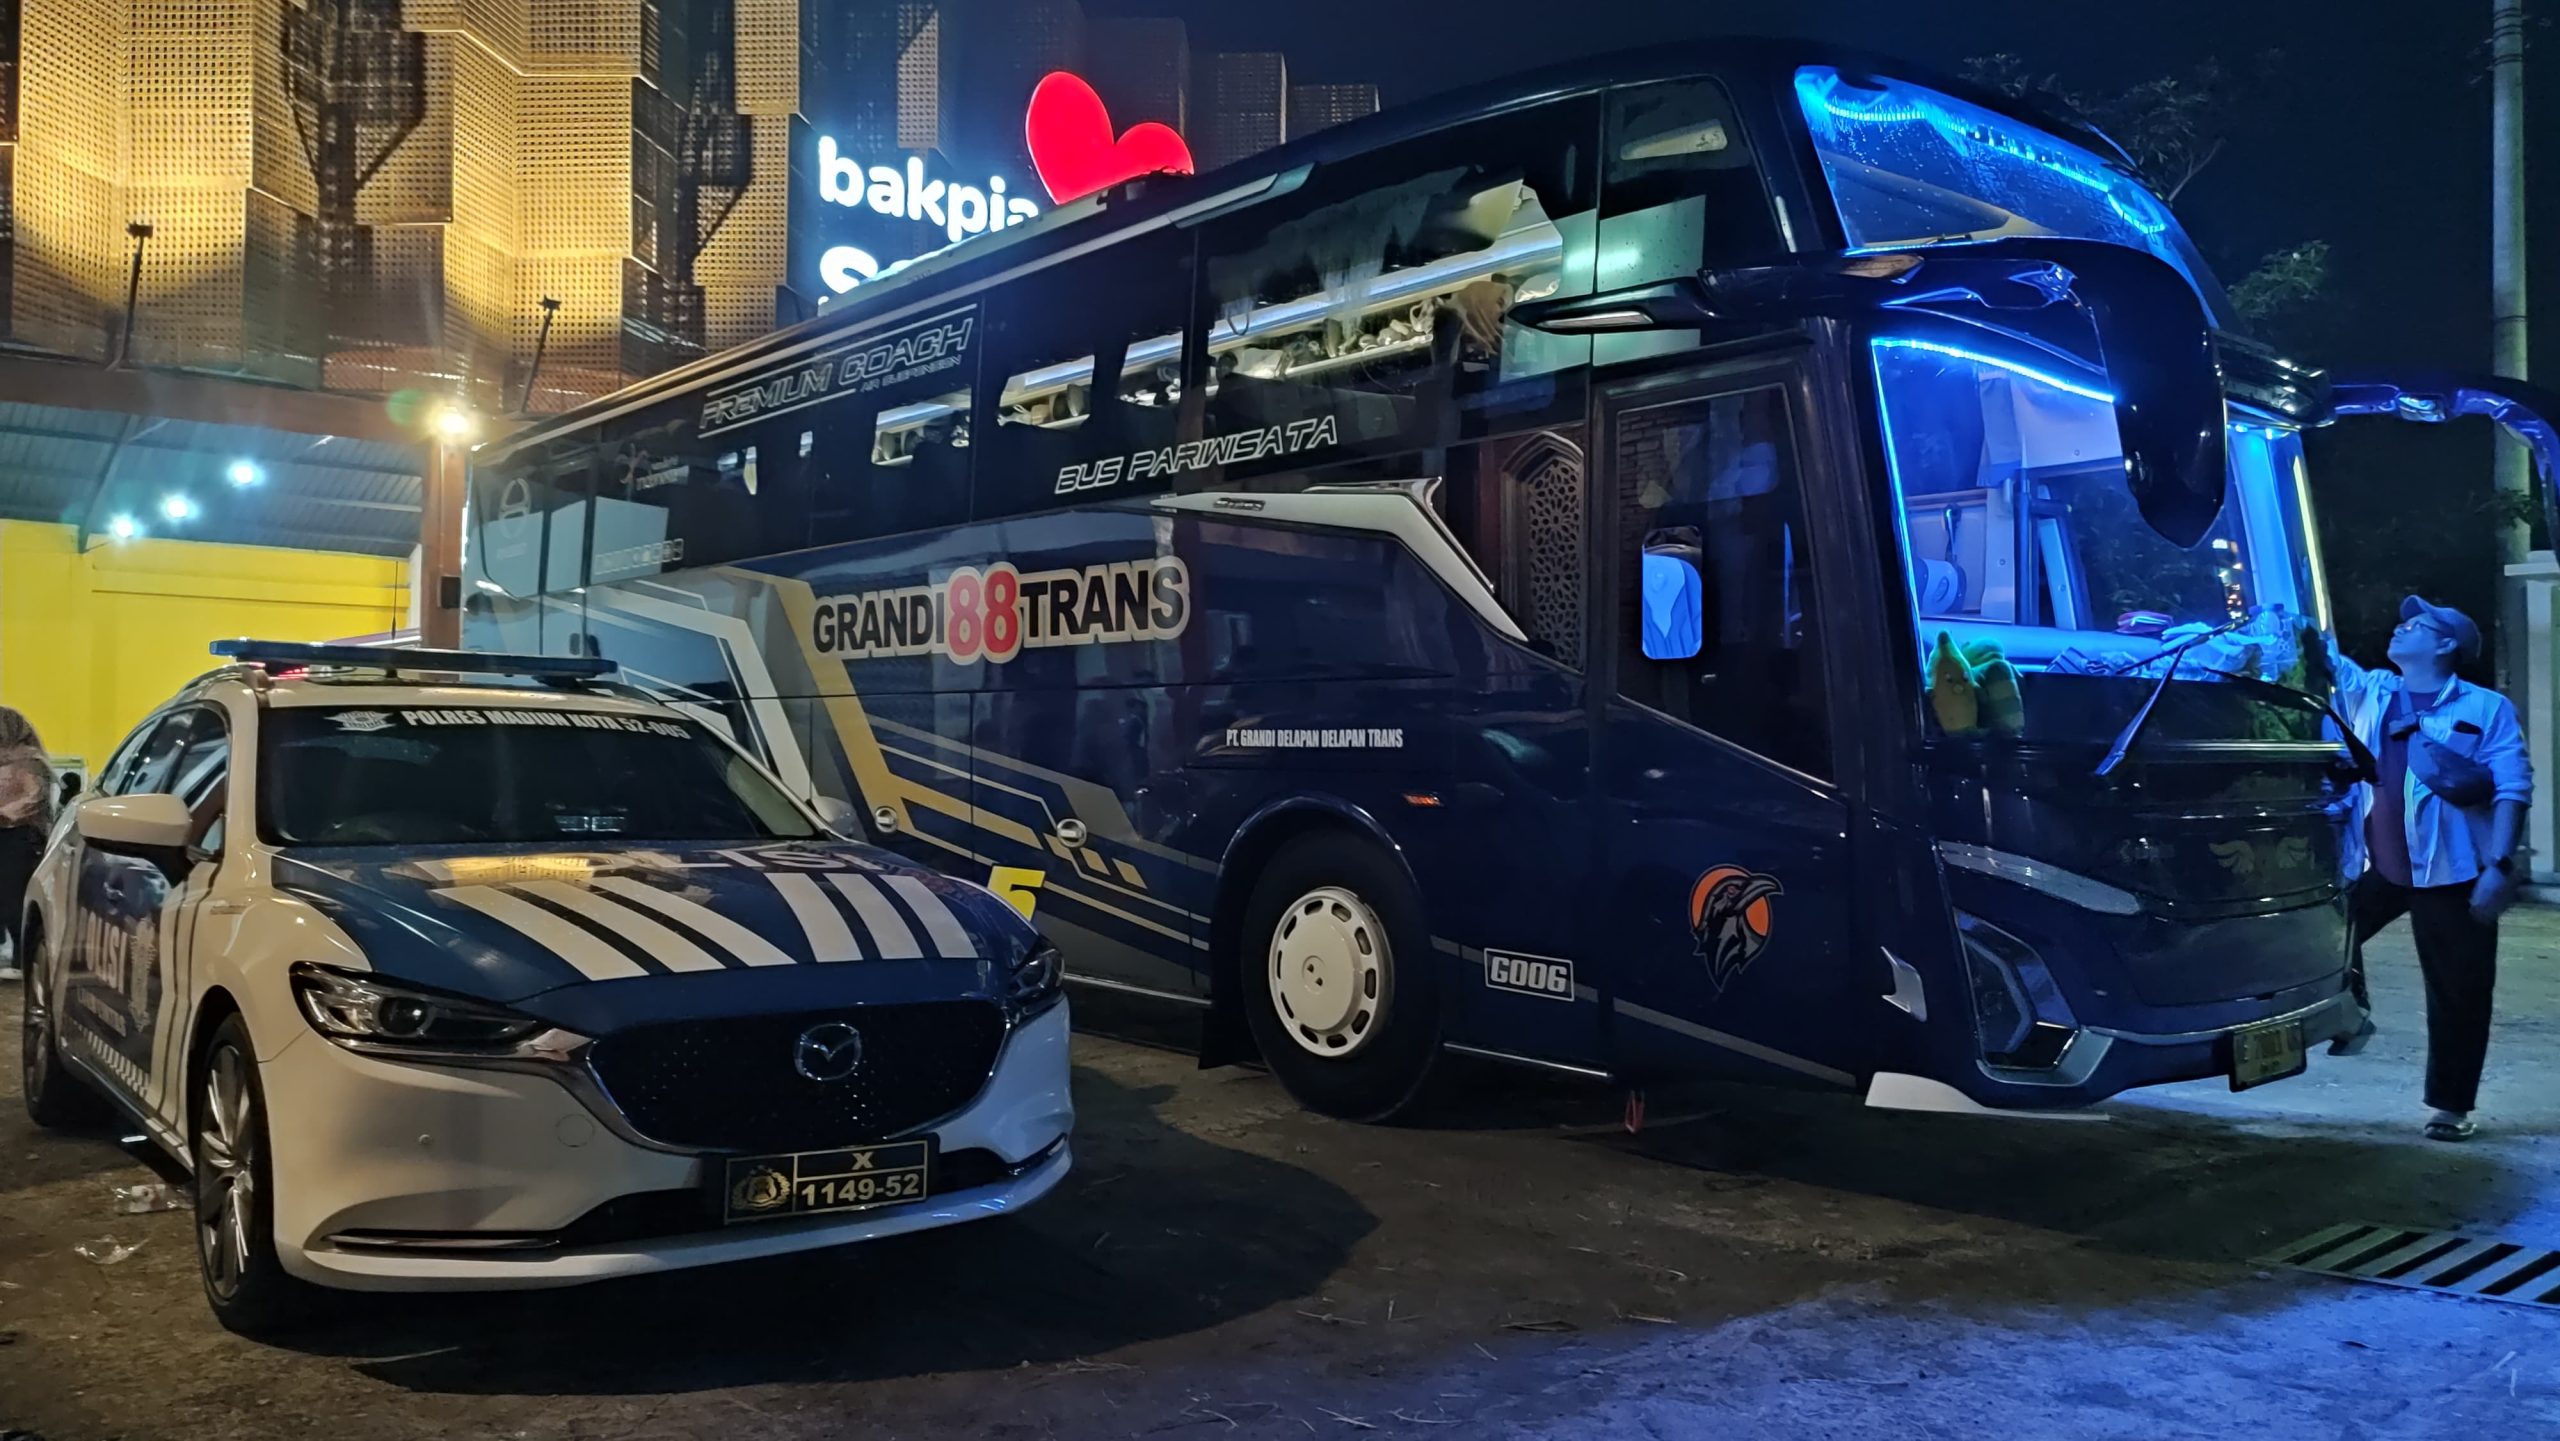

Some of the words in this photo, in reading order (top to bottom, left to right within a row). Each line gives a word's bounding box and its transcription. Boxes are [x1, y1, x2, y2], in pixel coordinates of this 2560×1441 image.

[817, 135, 1040, 243] bakpia
[698, 362, 833, 430] PREMIUM
[838, 317, 974, 386] COACH
[1054, 455, 1125, 495] BUS
[1126, 414, 1338, 482] PARIWISATA
[400, 709, 488, 726] POLRES
[482, 710, 572, 727] MADIUN
[565, 713, 624, 730] KOTA
[1240, 729, 1276, 747] GRANDI
[1277, 729, 1320, 748] DELAPAN
[1321, 729, 1366, 748] DELAPAN
[1367, 728, 1404, 748] TRANS
[852, 1151, 874, 1171] X
[801, 1173, 920, 1206] 1149-52
